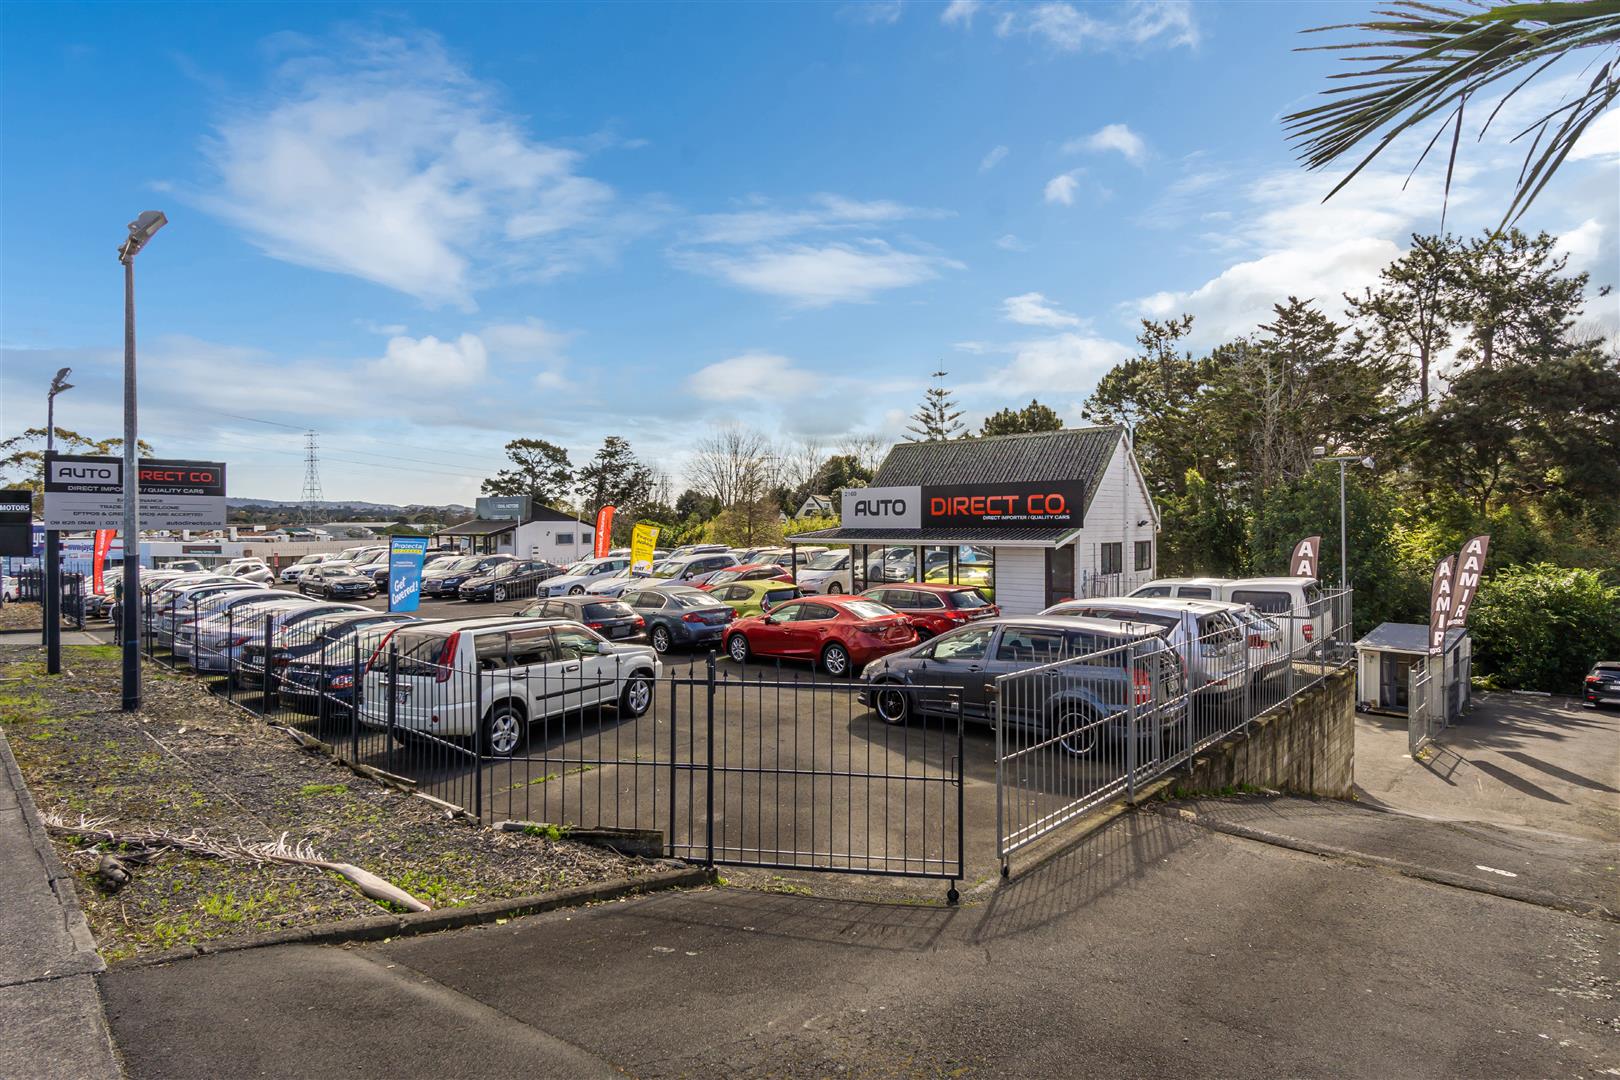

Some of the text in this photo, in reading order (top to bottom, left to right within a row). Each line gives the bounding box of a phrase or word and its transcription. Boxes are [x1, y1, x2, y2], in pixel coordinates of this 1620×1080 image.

[58, 467, 215, 483] AUTO RECT CO.
[854, 493, 1071, 517] AUTO DIRECT CO.
[394, 542, 423, 550] Protecta
[394, 576, 407, 592] Get
[1455, 540, 1482, 618] AAMIR
[391, 580, 419, 606] Covered!
